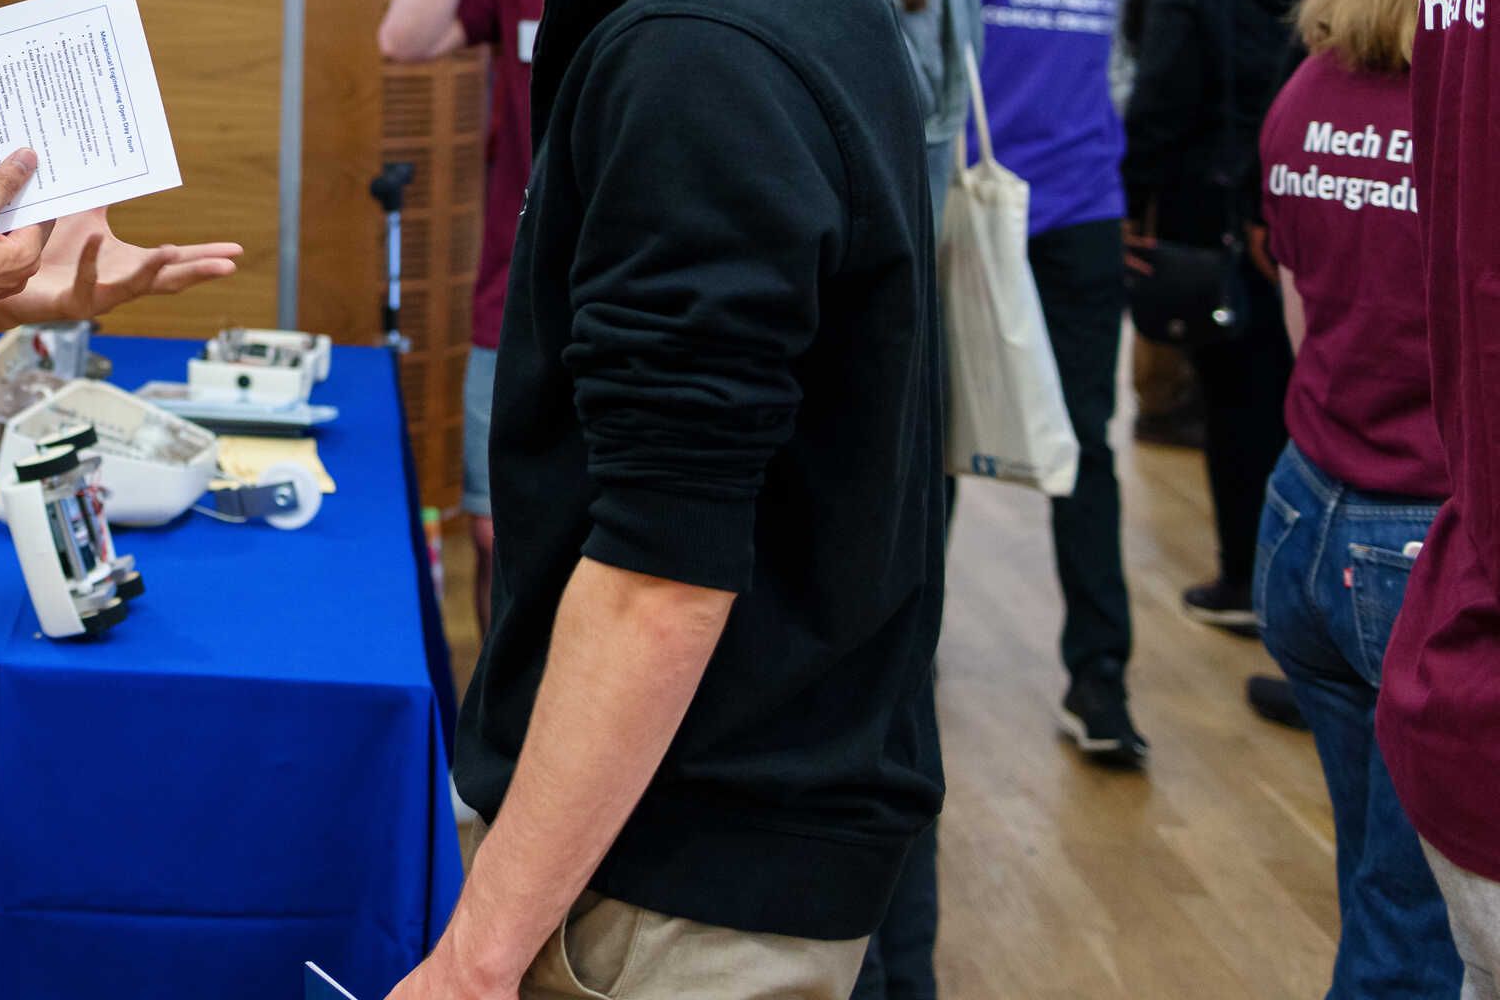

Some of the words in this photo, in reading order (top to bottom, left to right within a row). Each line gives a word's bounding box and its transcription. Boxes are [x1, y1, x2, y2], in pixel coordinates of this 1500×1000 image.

[100, 31, 114, 67] Mechanical
[109, 67, 122, 105] Engineering
[118, 104, 126, 122] Open
[126, 135, 134, 153] Tours
[1304, 121, 1382, 158] Mech
